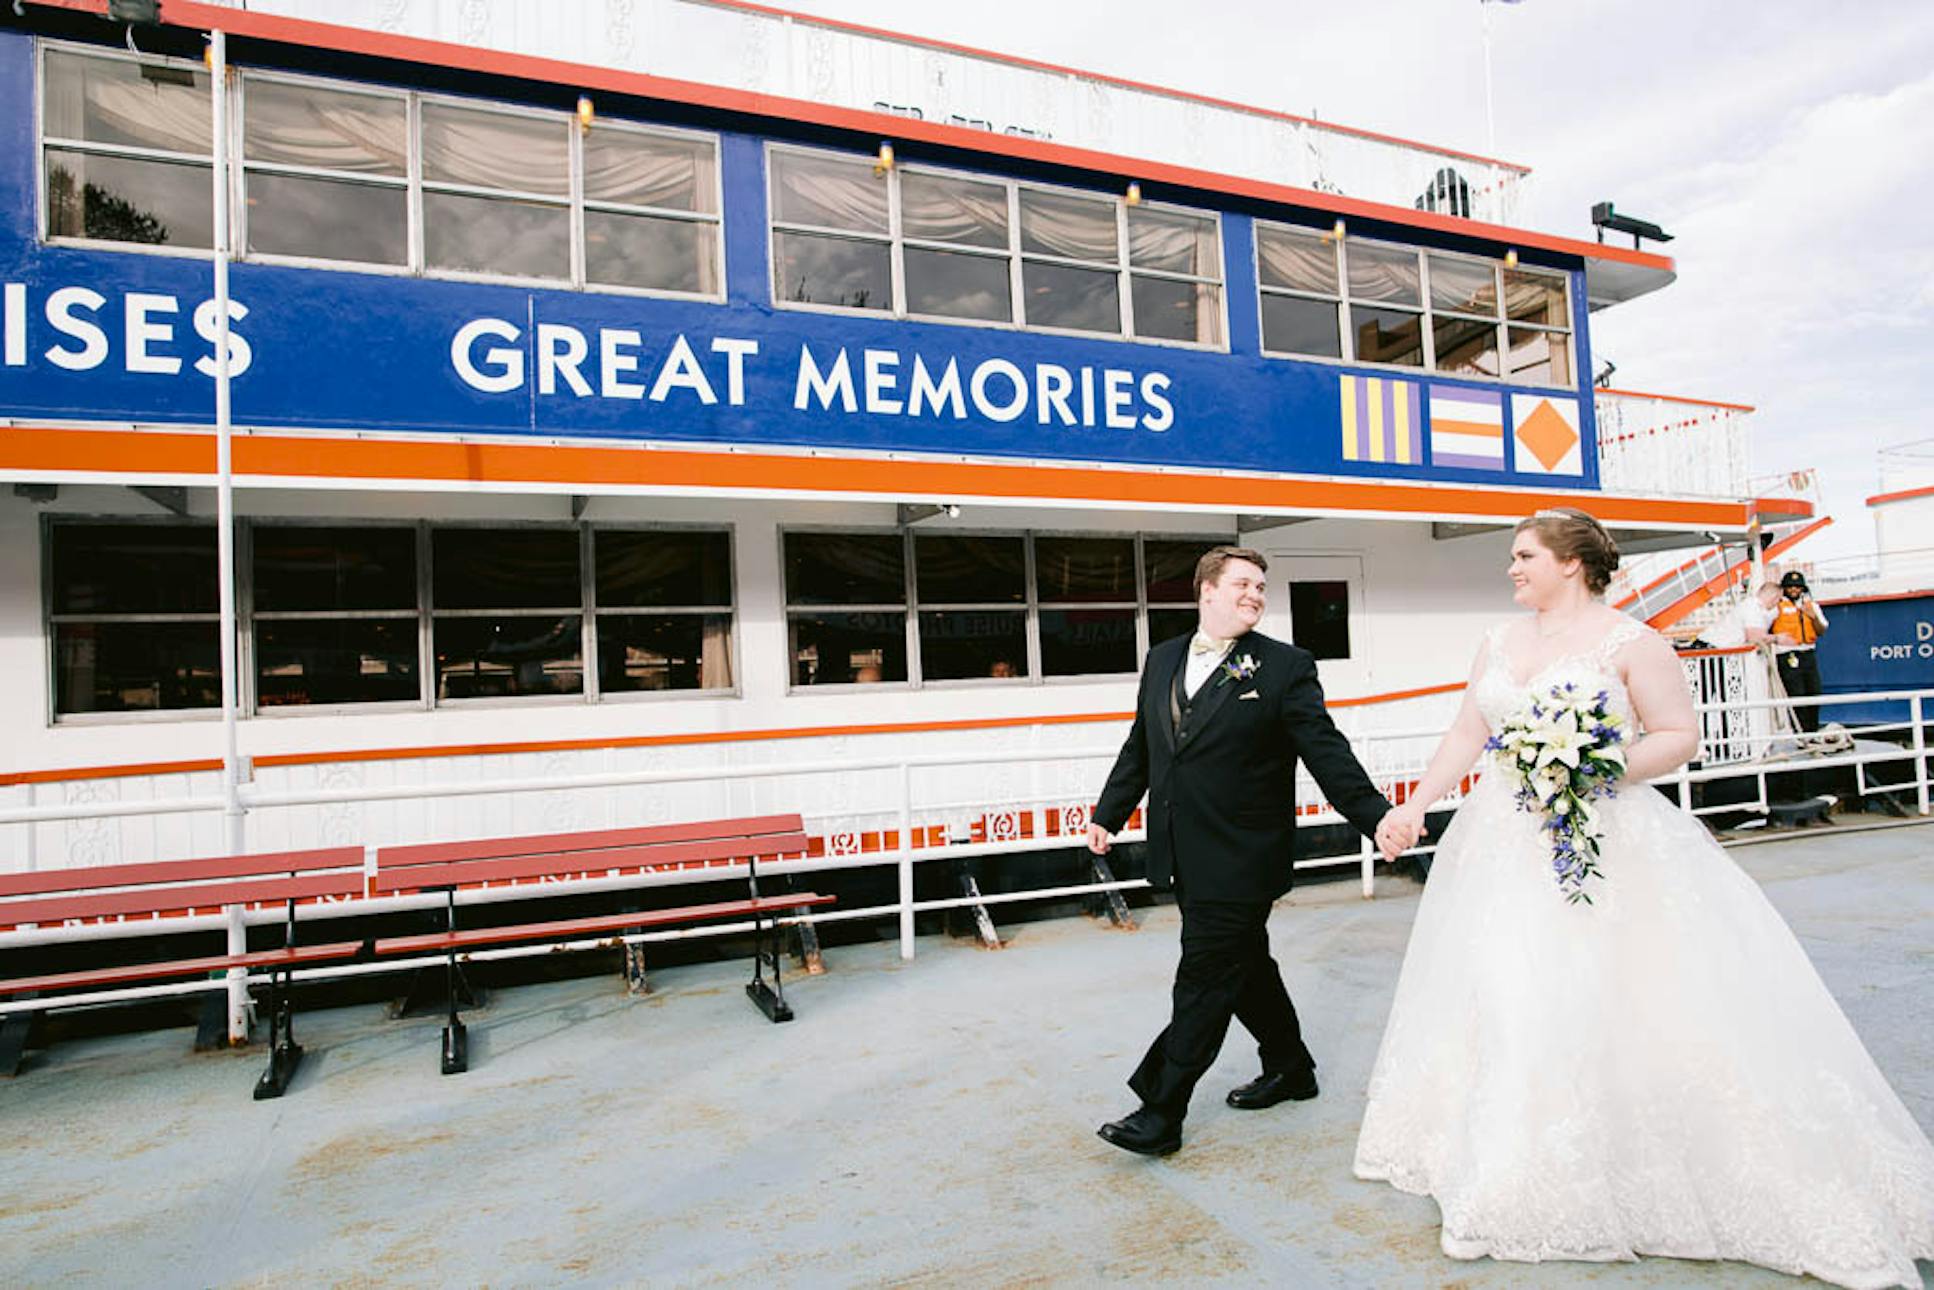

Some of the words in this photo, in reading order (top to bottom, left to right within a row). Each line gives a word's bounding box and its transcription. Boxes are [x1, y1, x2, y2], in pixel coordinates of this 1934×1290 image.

[4, 283, 253, 378] ISES
[451, 318, 758, 406] GREAT
[794, 343, 1174, 432] MEMORIES
[1870, 645, 1914, 660] PORT
[1918, 643, 1934, 658] O
